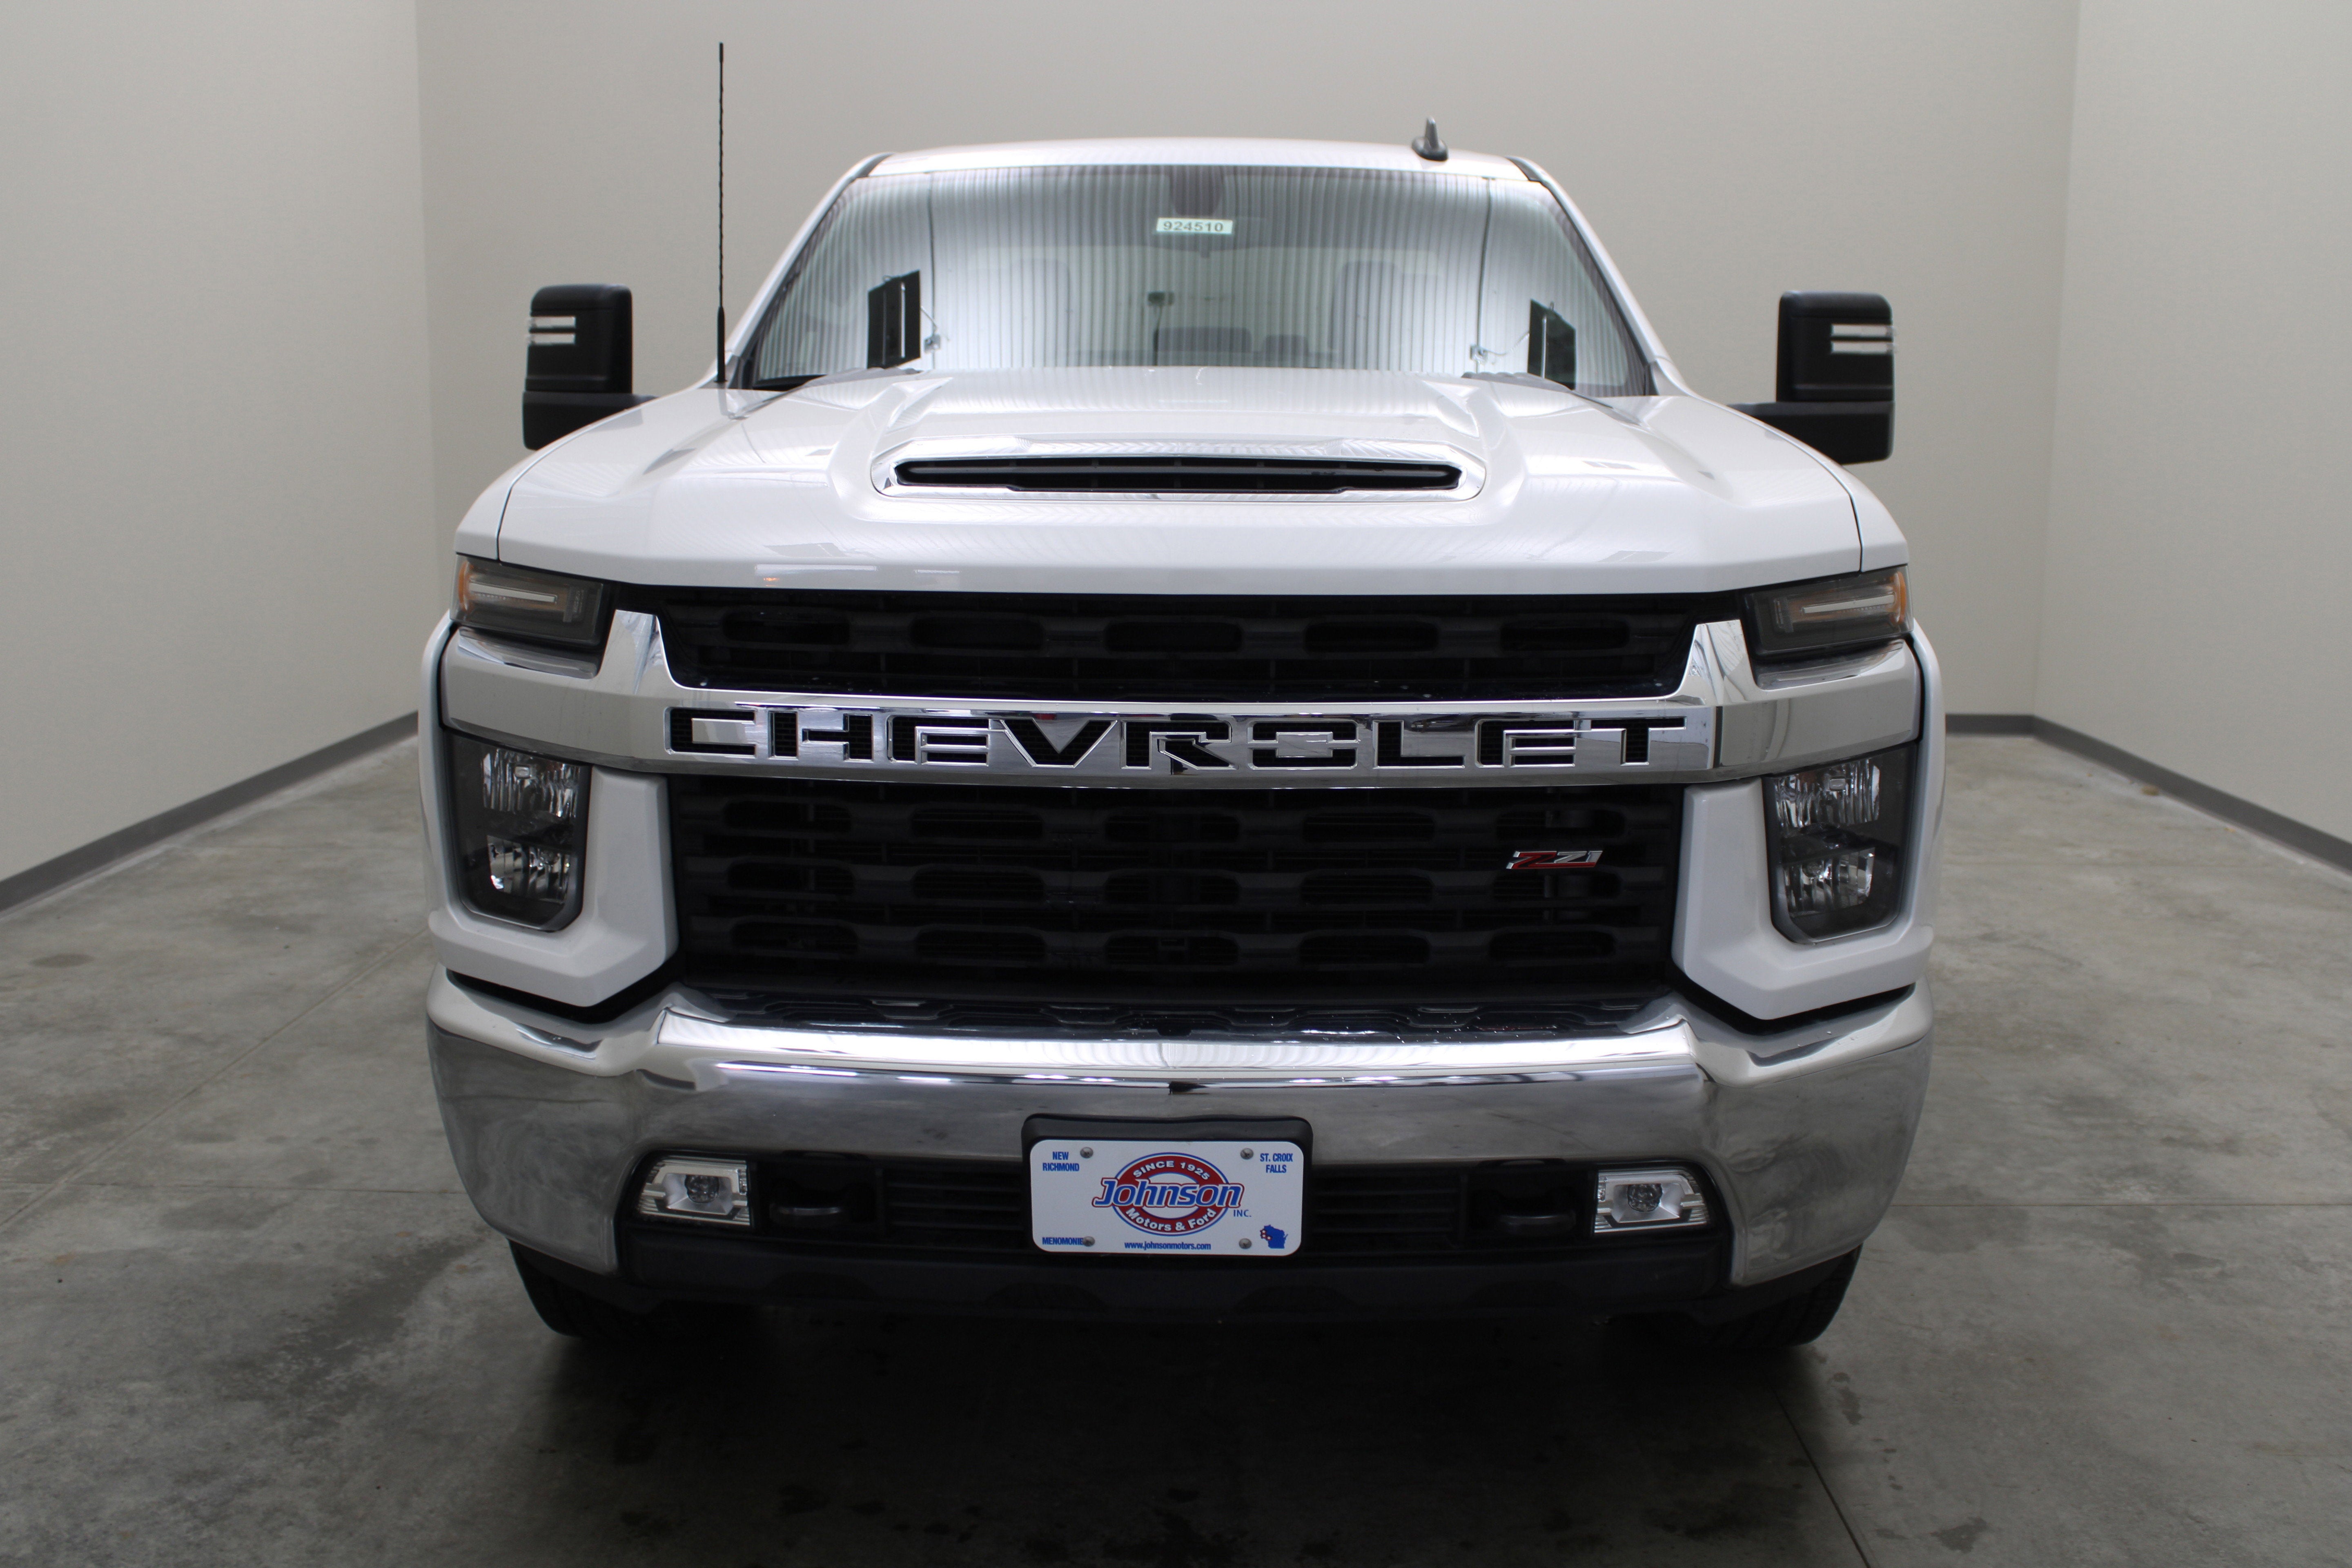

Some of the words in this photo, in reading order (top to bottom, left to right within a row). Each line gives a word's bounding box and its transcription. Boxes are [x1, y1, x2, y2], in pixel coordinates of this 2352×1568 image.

[1163, 220, 1224, 232] 924510
[664, 707, 1687, 770] CHEVROLET
[1506, 851, 1603, 869] Z71
[1052, 1152, 1069, 1160] NEW
[1260, 1153, 1271, 1162] ST.
[1272, 1153, 1293, 1162] CROIX
[1042, 1163, 1080, 1172] RICHMOND
[1133, 1160, 1174, 1178] SINCE
[1180, 1162, 1210, 1180] 1925
[1266, 1164, 1287, 1173] FALLS
[1093, 1179, 1243, 1207] Johnson
[1125, 1207, 1172, 1232] Motors
[1175, 1222, 1186, 1232] &
[1187, 1208, 1217, 1229] Ford
[1042, 1237, 1084, 1245] MENOMONIE
[1124, 1241, 1212, 1250] www.johnsonmotors.com
